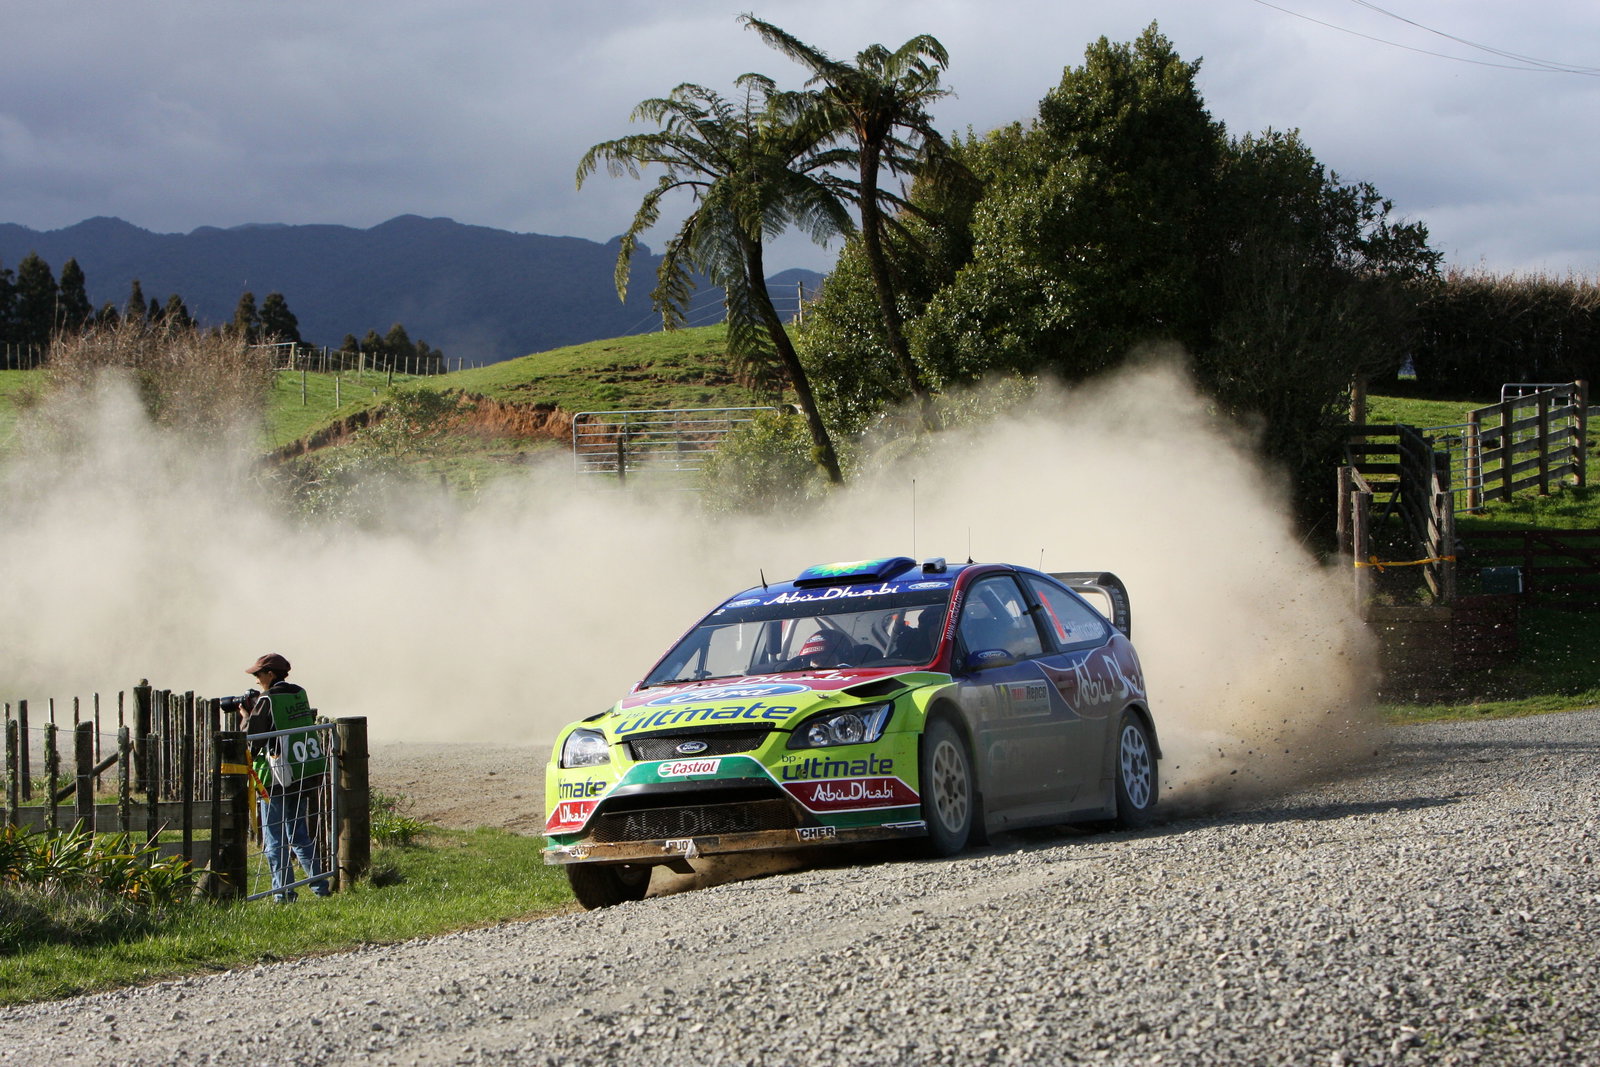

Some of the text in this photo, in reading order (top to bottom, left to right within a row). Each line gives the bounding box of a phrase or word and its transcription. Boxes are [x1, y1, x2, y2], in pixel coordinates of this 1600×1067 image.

[763, 582, 900, 606] Abu Dhabi
[722, 671, 857, 685] Dhabi
[1101, 651, 1145, 699] Dhab
[292, 737, 321, 763] 03
[781, 754, 796, 764] bp
[671, 760, 717, 775] Castrol
[782, 753, 893, 780] ultimate
[810, 779, 894, 802] Abu Dhabi
[799, 826, 835, 840] CHER
